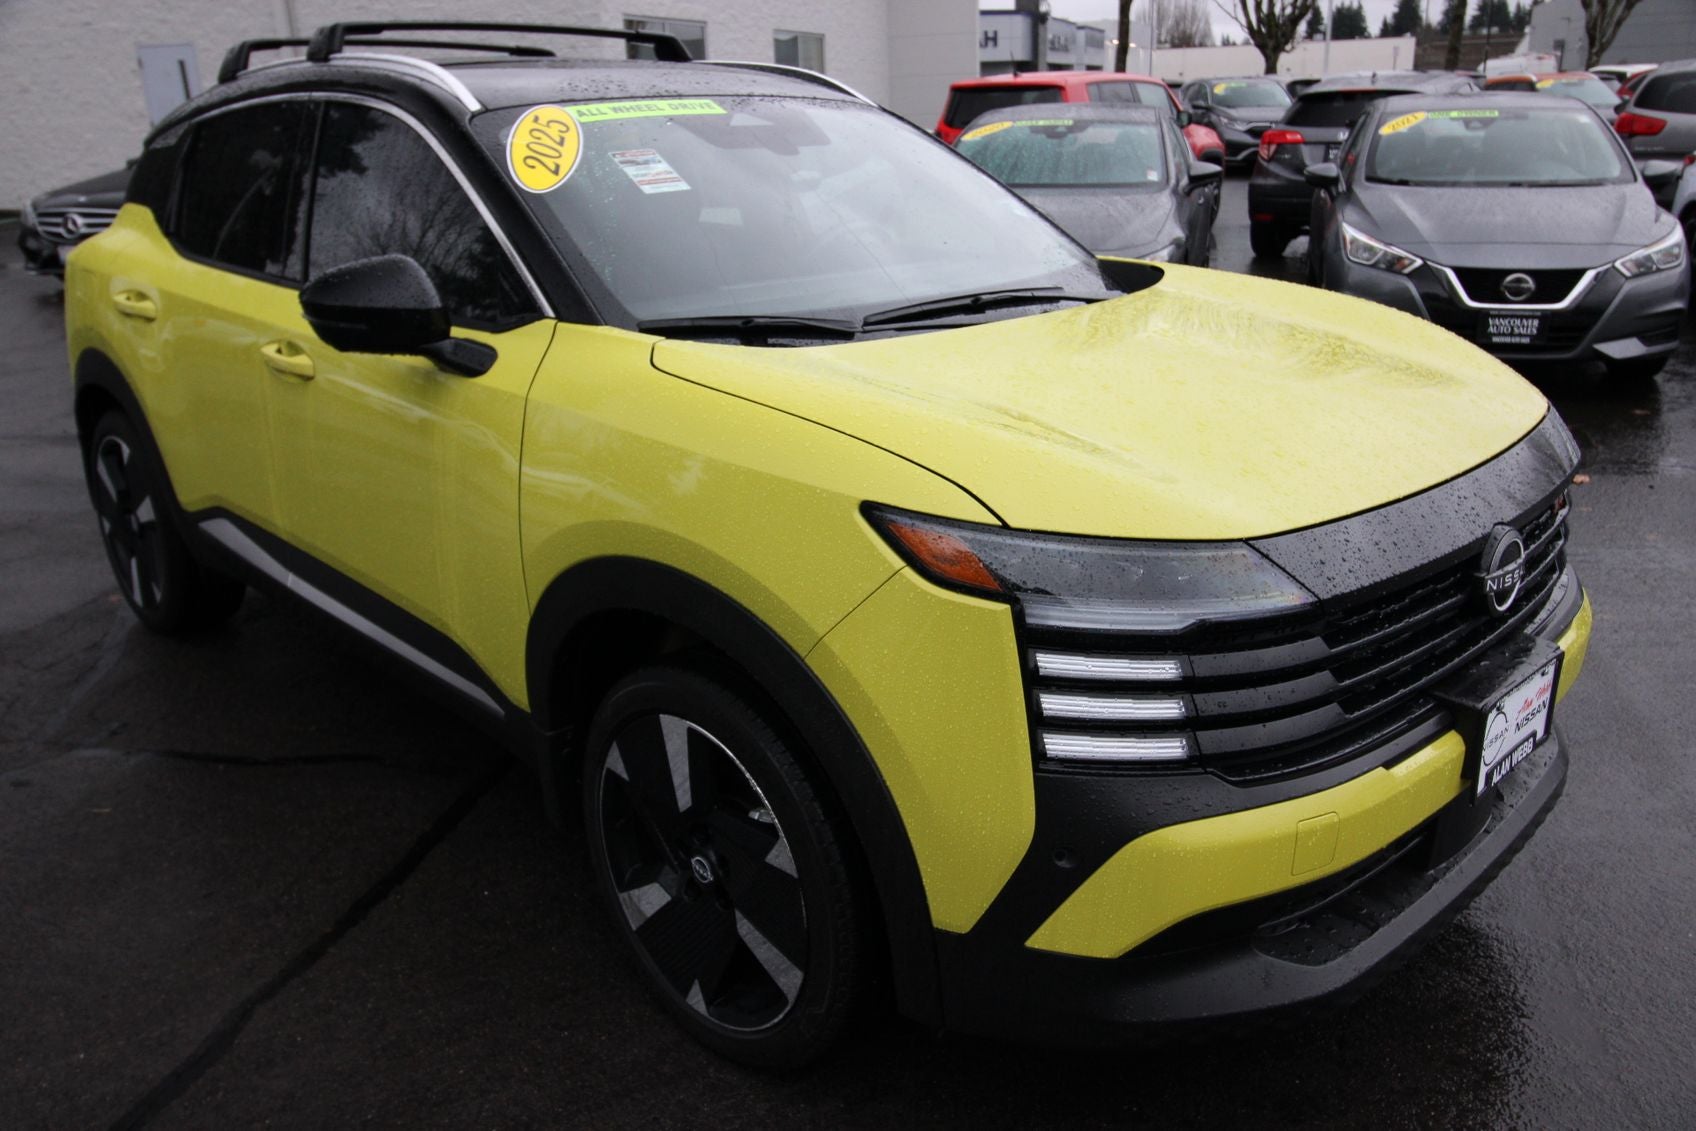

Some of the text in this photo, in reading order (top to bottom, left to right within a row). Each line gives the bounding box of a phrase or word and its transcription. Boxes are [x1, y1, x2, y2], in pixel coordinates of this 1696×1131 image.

[576, 102, 717, 118] ALL WHEEL DRIVE
[522, 115, 571, 177] 2025
[1487, 325, 1537, 335] AUTO SALES
[1488, 317, 1539, 327] VANCOUVER
[1514, 697, 1549, 734] NISSAN
[1491, 736, 1534, 787] ALAN WEBB
